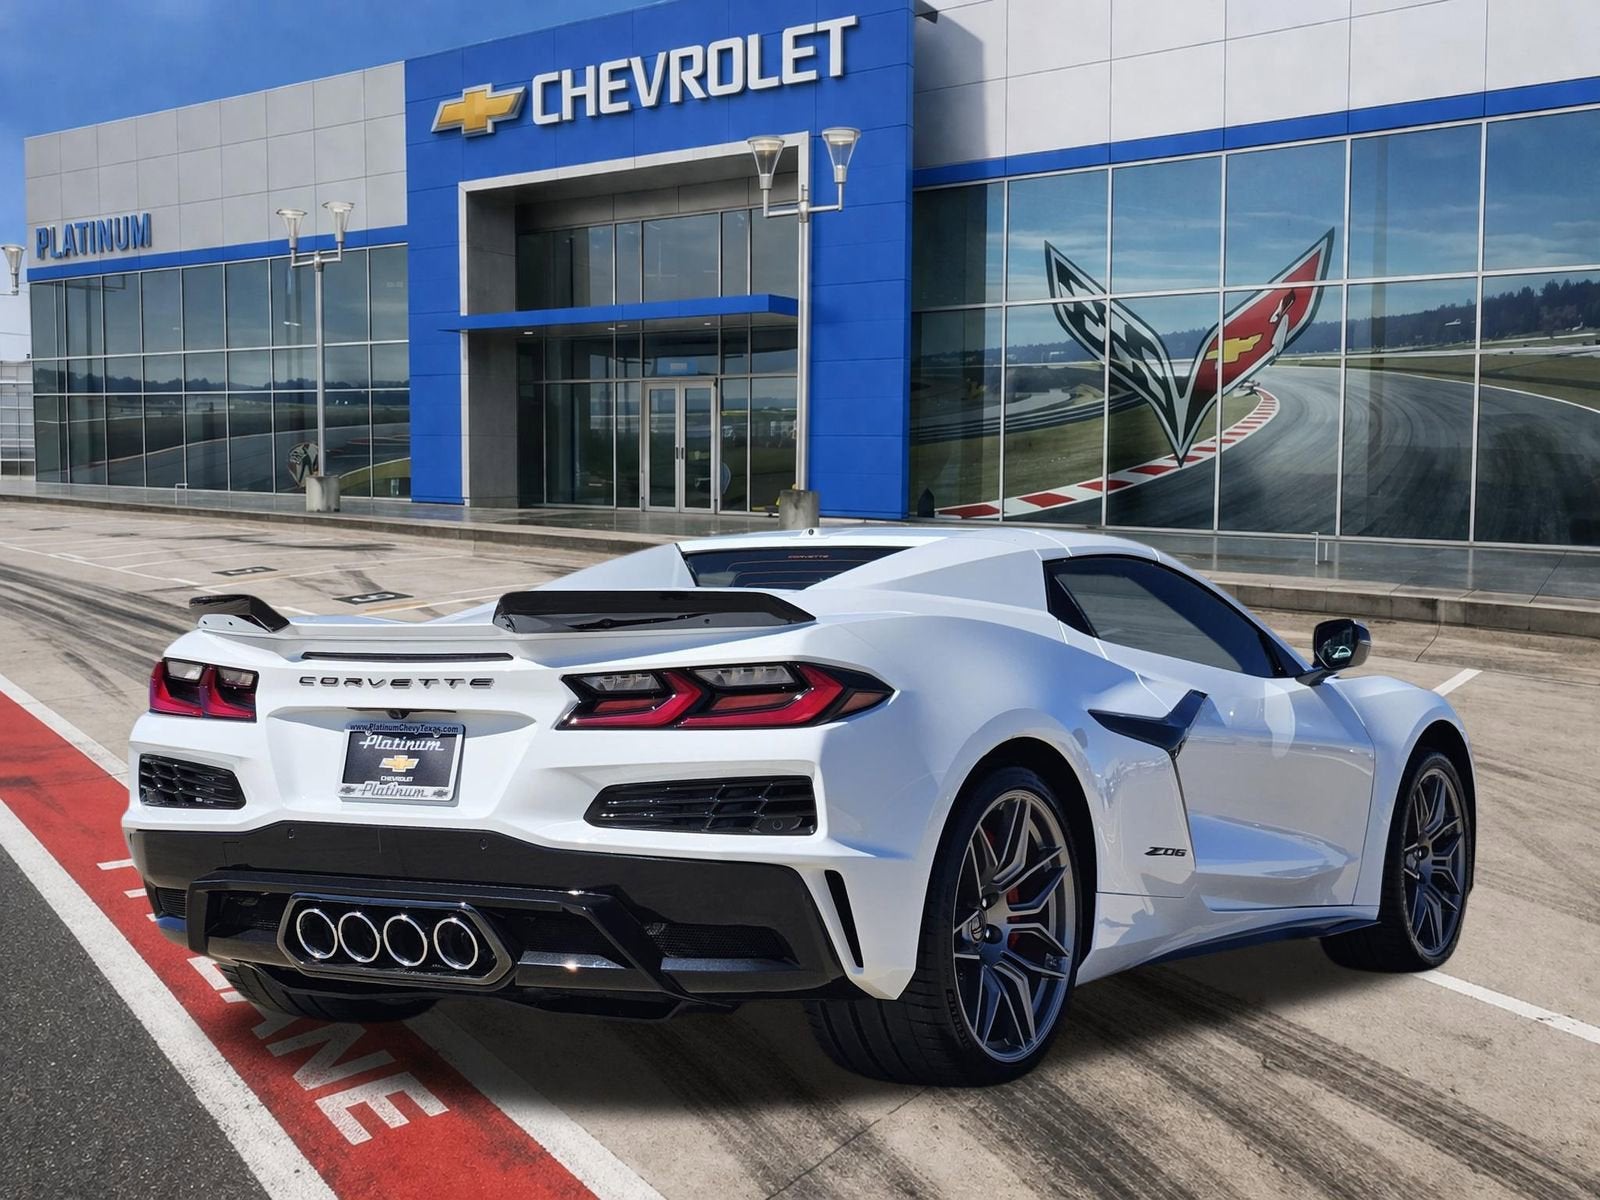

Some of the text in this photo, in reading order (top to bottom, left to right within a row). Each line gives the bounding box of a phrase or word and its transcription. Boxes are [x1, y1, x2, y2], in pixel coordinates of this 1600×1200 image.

[532, 15, 858, 125] CHEVROLET
[36, 213, 152, 260] PLATINUM
[299, 676, 494, 689] CORVETTE
[350, 723, 459, 735] www.PlatinumChevyTexas.com
[359, 735, 445, 751] Platinum
[360, 782, 429, 798] Platinum
[1144, 846, 1187, 857] Z06
